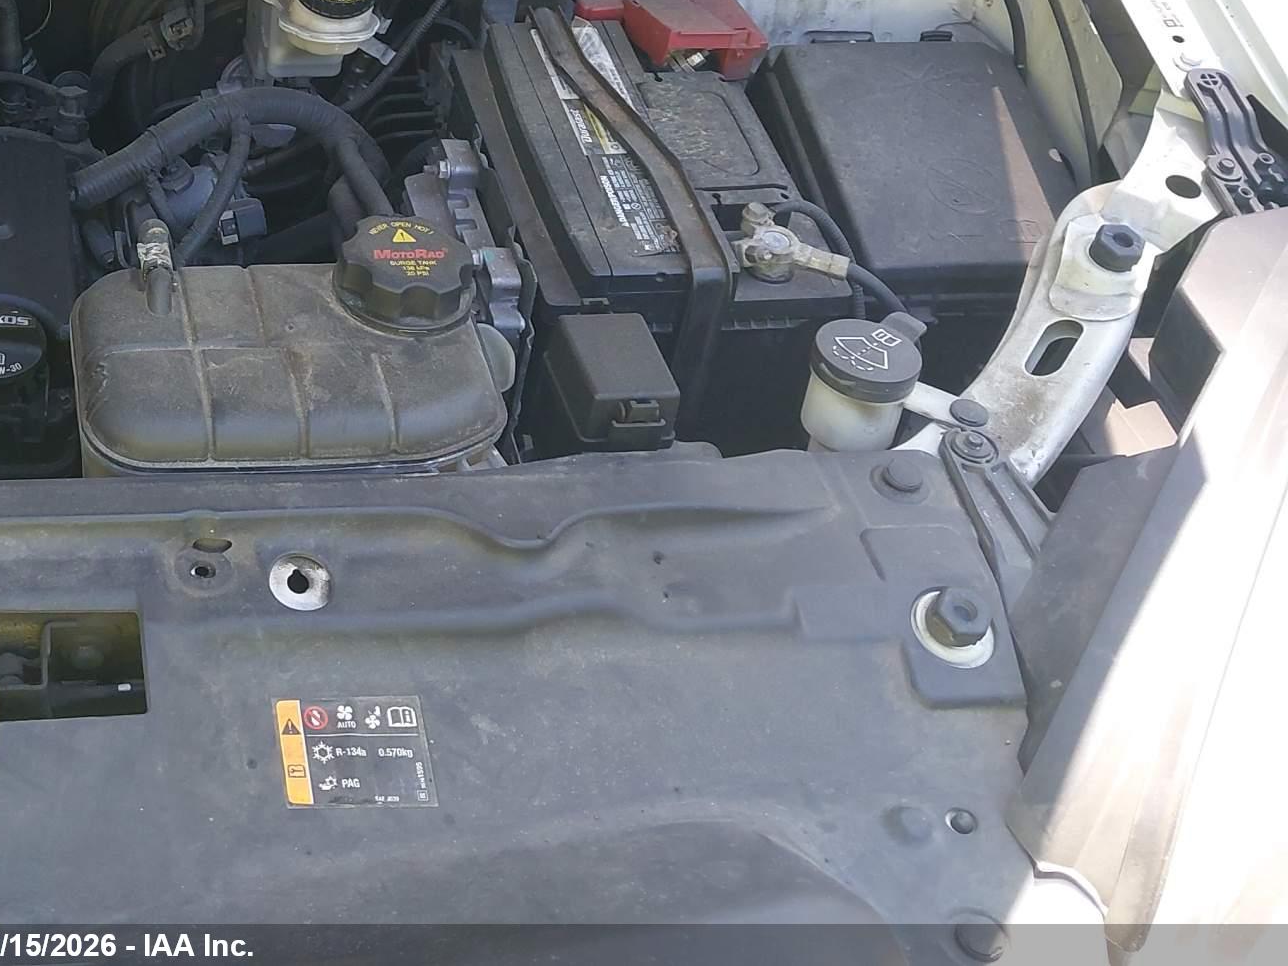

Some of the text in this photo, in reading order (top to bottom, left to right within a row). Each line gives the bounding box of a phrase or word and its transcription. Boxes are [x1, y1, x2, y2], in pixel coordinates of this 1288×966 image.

[337, 720, 357, 729] AUTO
[336, 746, 414, 759] R-134a 0.570kg
[341, 778, 361, 789] PAG
